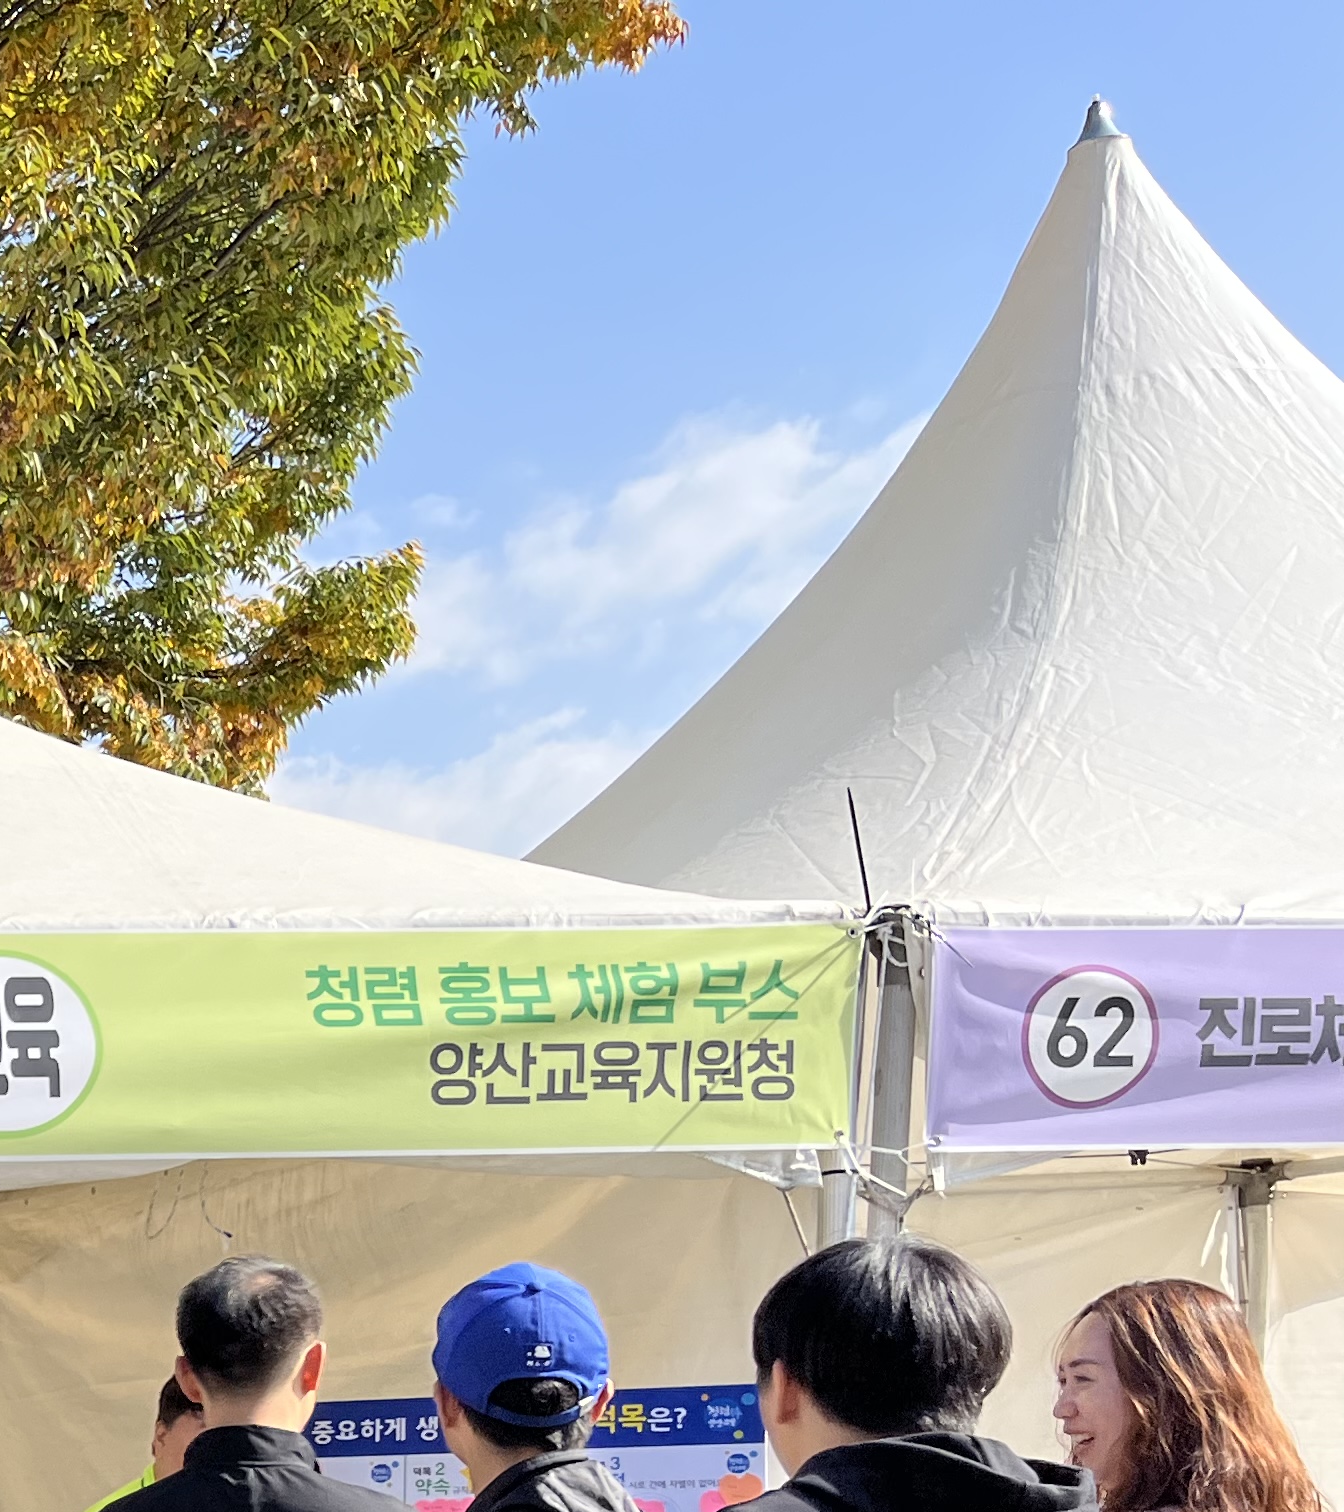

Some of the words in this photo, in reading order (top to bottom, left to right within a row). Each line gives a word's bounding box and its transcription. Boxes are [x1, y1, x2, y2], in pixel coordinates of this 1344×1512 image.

[304, 962, 424, 1027] 청렴
[438, 961, 556, 1025] 홍보
[570, 961, 679, 1025] 체험
[693, 958, 800, 1024] 부스
[1045, 995, 1135, 1069] 62
[429, 1037, 796, 1107] 양산교육지원청
[311, 1416, 407, 1445] 중요하게
[435, 1462, 446, 1476] 2
[610, 1456, 621, 1470] 3
[414, 1477, 451, 1496] 약속
